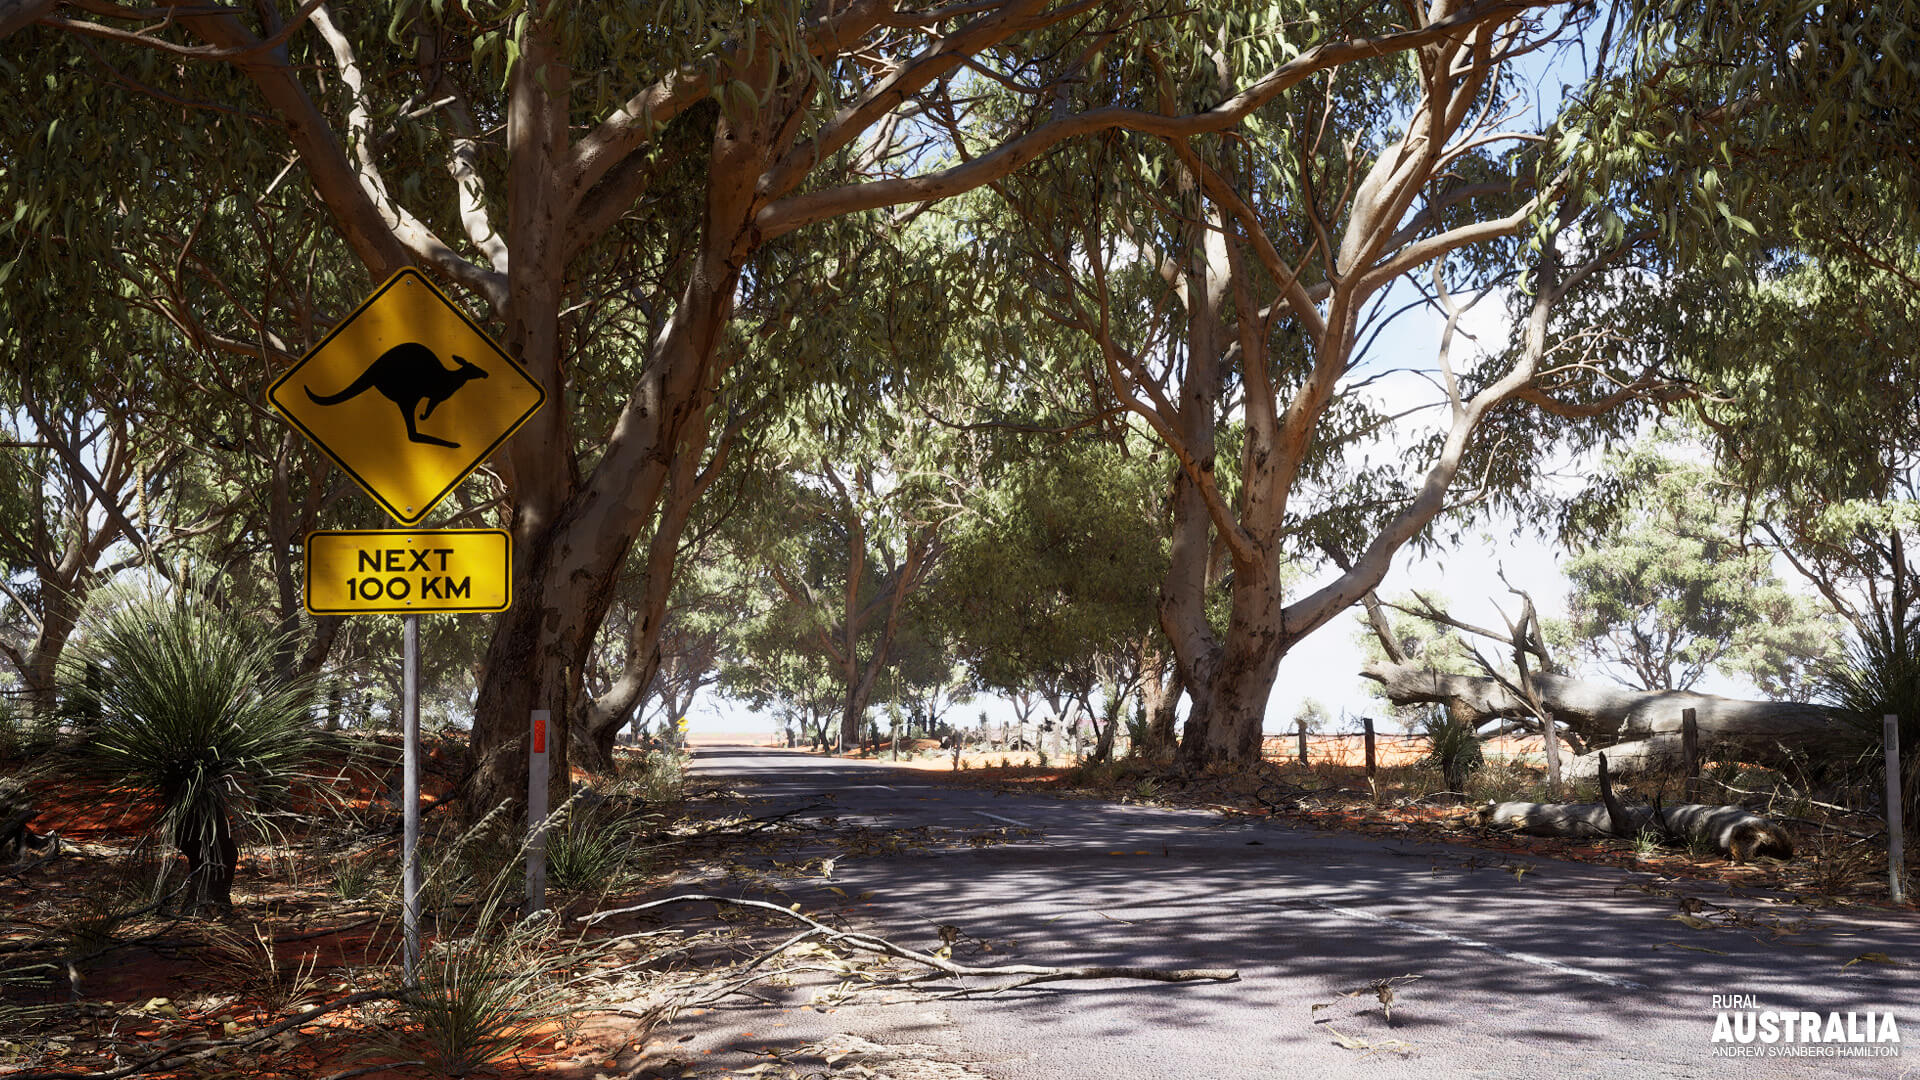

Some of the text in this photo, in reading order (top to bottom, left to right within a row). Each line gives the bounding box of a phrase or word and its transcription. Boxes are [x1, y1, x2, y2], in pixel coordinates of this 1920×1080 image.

[358, 549, 454, 572] NEXT
[346, 576, 471, 601] 100 KM
